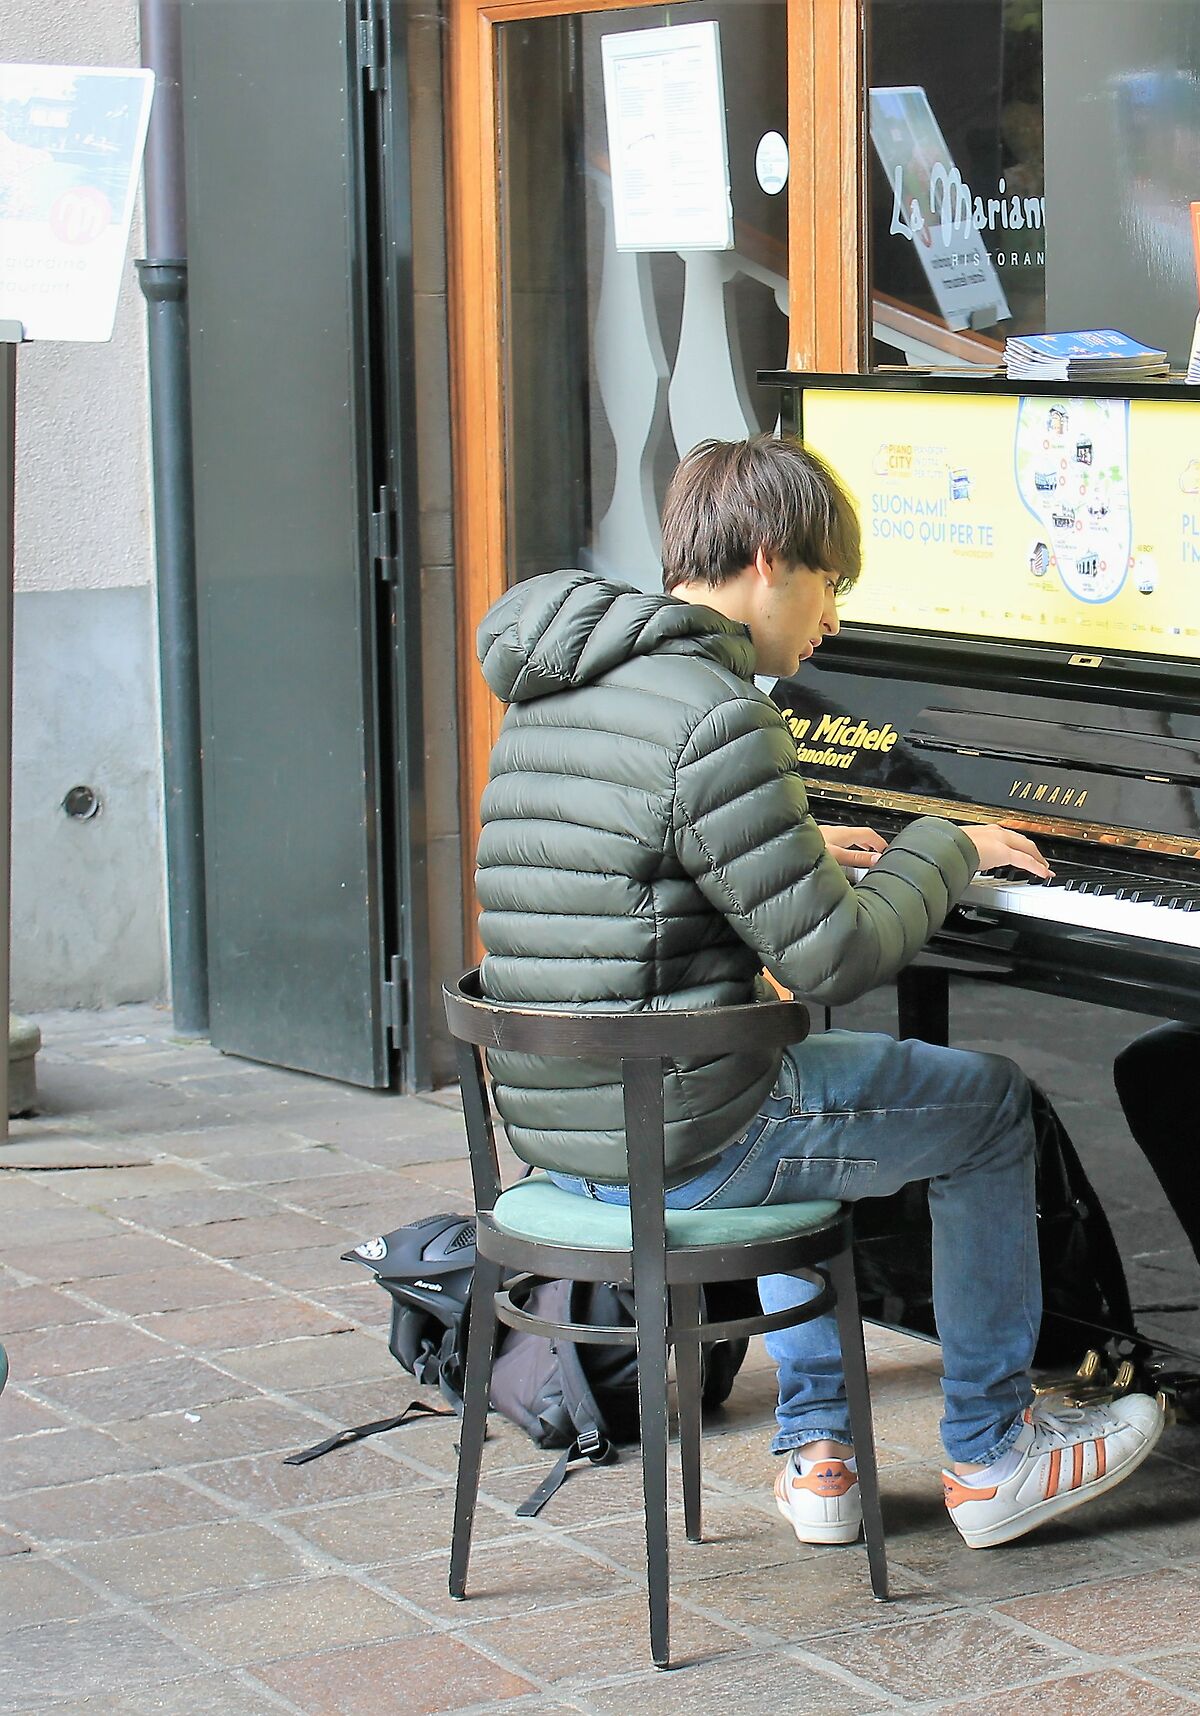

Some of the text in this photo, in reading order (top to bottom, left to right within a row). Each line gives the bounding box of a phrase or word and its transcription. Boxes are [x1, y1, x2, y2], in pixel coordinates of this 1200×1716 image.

[890, 165, 925, 241] La
[888, 444, 912, 456] PIANO
[888, 455, 912, 469] CITY
[872, 493, 947, 517] SUONAMI!
[872, 518, 993, 546] SONO QUI PER TE
[780, 708, 899, 753] San Michele
[796, 742, 857, 769] ianoforti
[1008, 780, 1089, 808] YAMAHA
